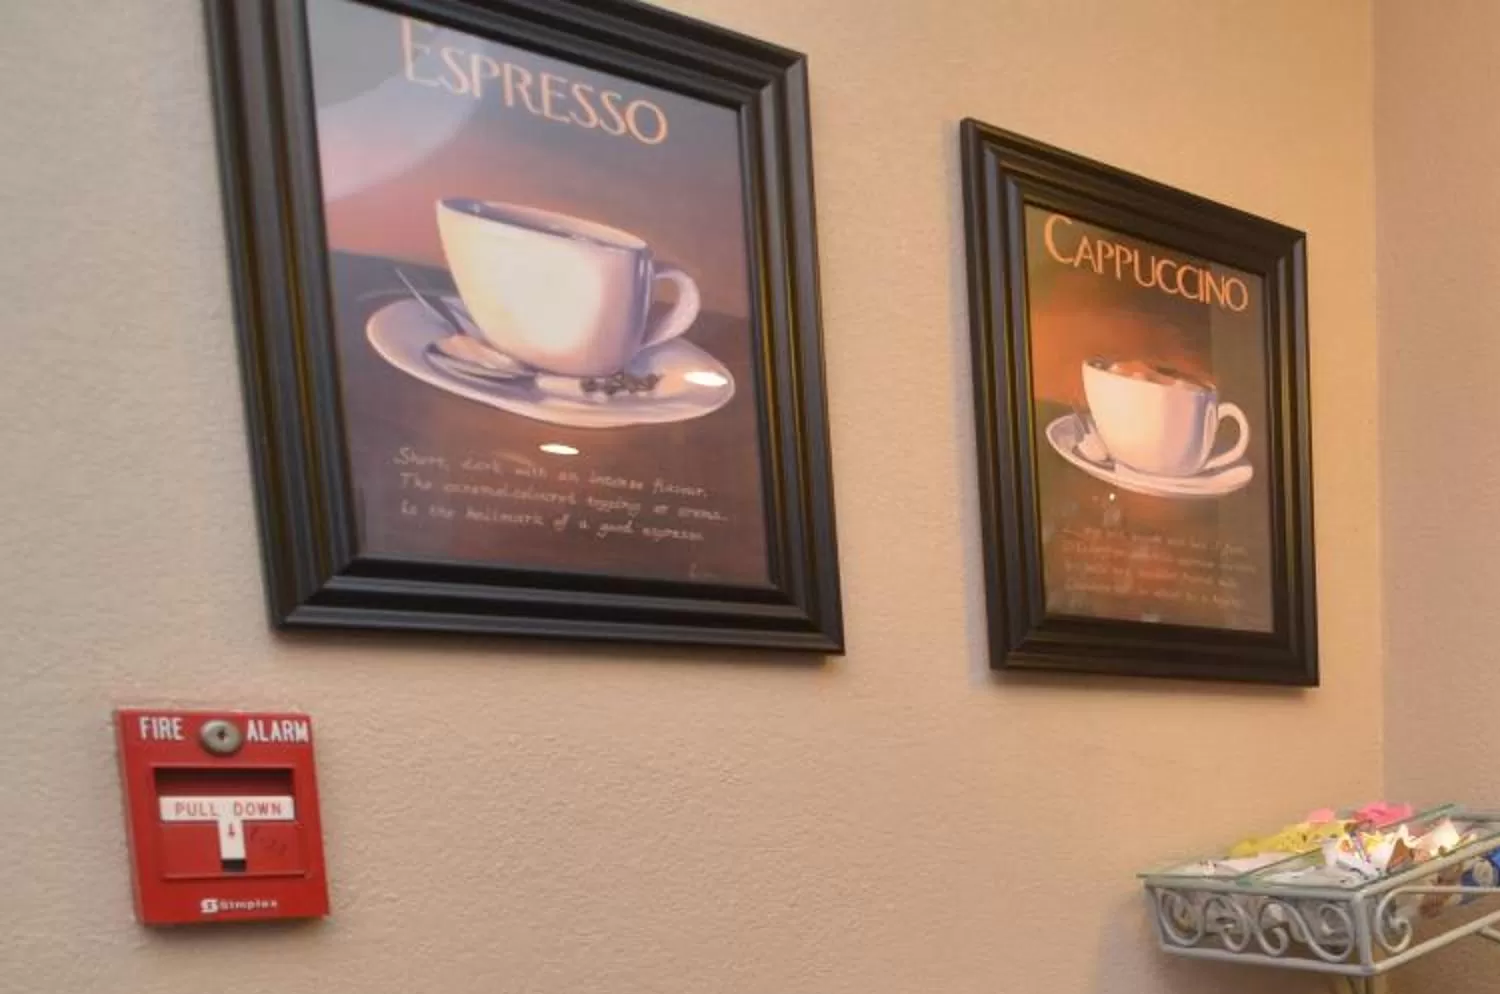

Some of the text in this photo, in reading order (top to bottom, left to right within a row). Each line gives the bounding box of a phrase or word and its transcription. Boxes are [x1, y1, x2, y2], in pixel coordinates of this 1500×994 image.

[400, 15, 669, 144] ESPRESSO
[1044, 213, 1249, 312] CAPPUCCINO
[139, 717, 310, 742] FIRE ALARM
[174, 801, 283, 817] PULL DOWN
